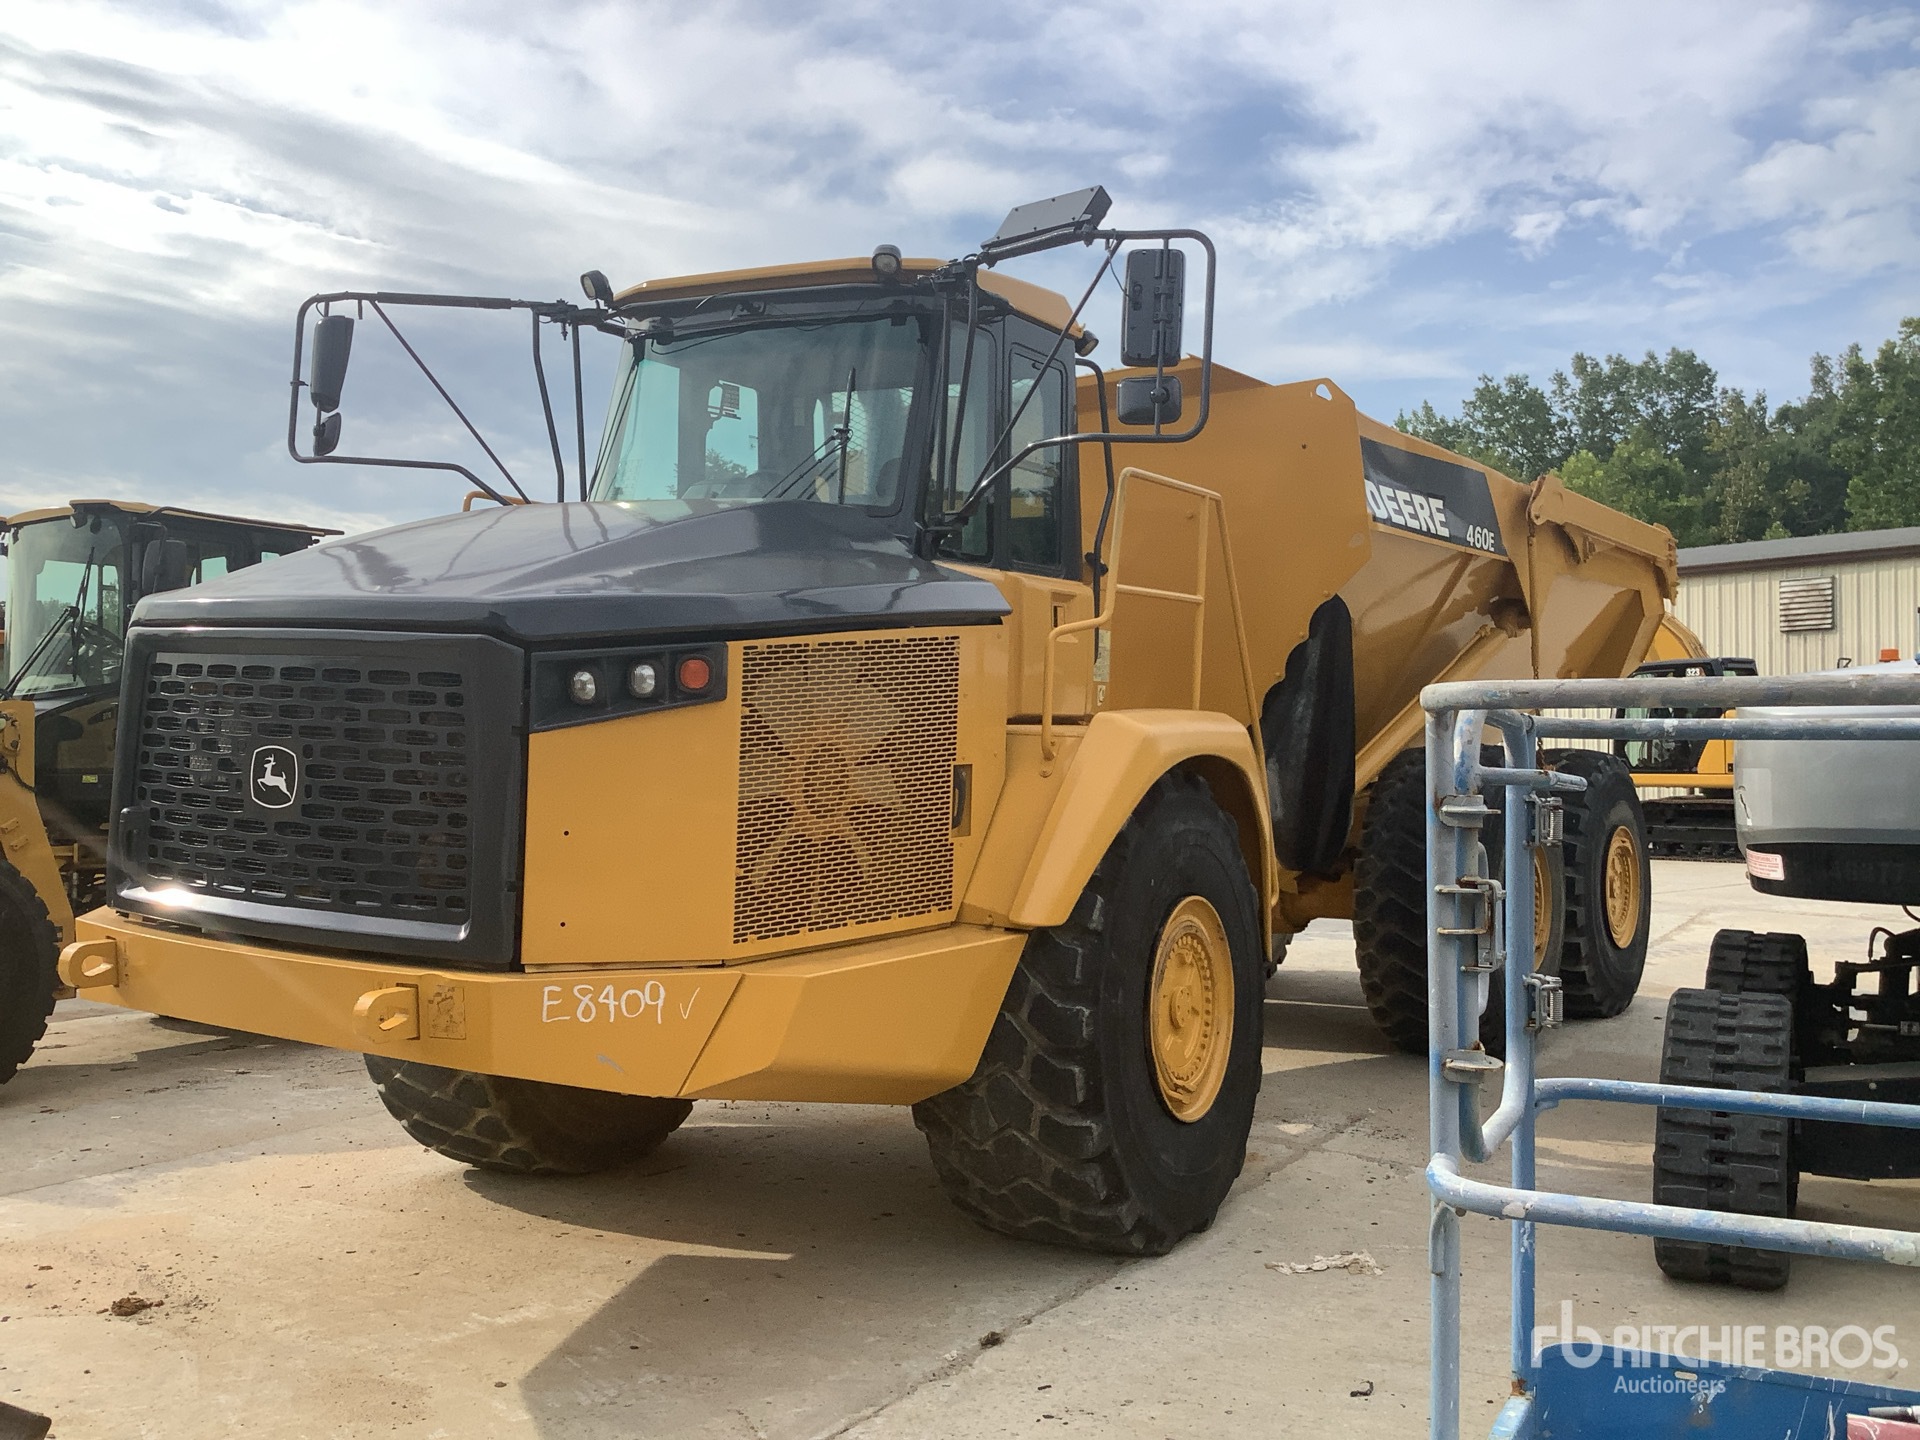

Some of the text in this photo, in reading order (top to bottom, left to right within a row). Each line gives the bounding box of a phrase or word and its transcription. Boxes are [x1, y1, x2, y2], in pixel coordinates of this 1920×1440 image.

[1364, 478, 1450, 538] DEERE
[1466, 524, 1495, 552] 460E
[1685, 667, 1701, 677] 323
[541, 980, 666, 1025] E8409
